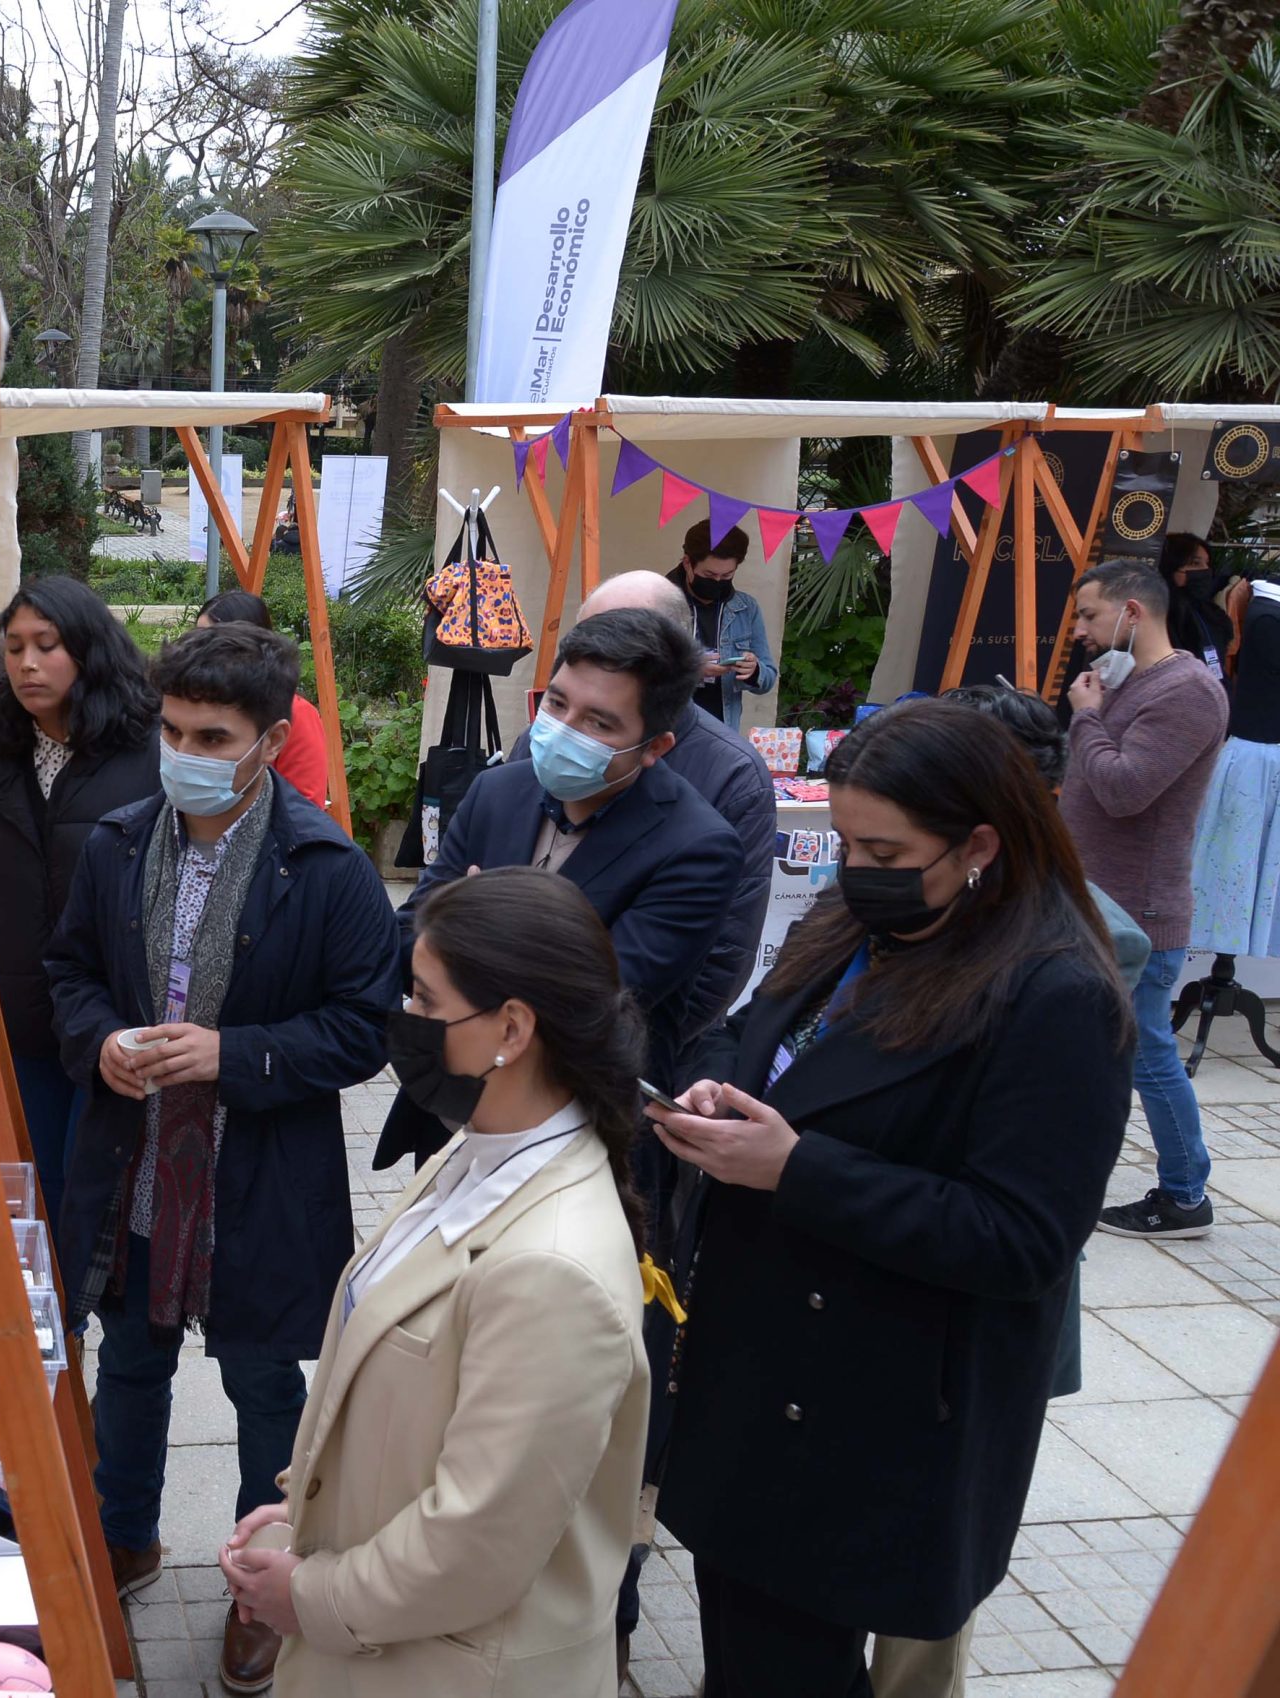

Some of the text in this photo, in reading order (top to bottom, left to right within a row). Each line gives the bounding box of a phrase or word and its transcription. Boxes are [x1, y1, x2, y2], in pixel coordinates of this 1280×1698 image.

[535, 207, 570, 332] Desarrollo
[550, 198, 590, 332] Económico
[774, 892, 807, 900] CÁMARA
